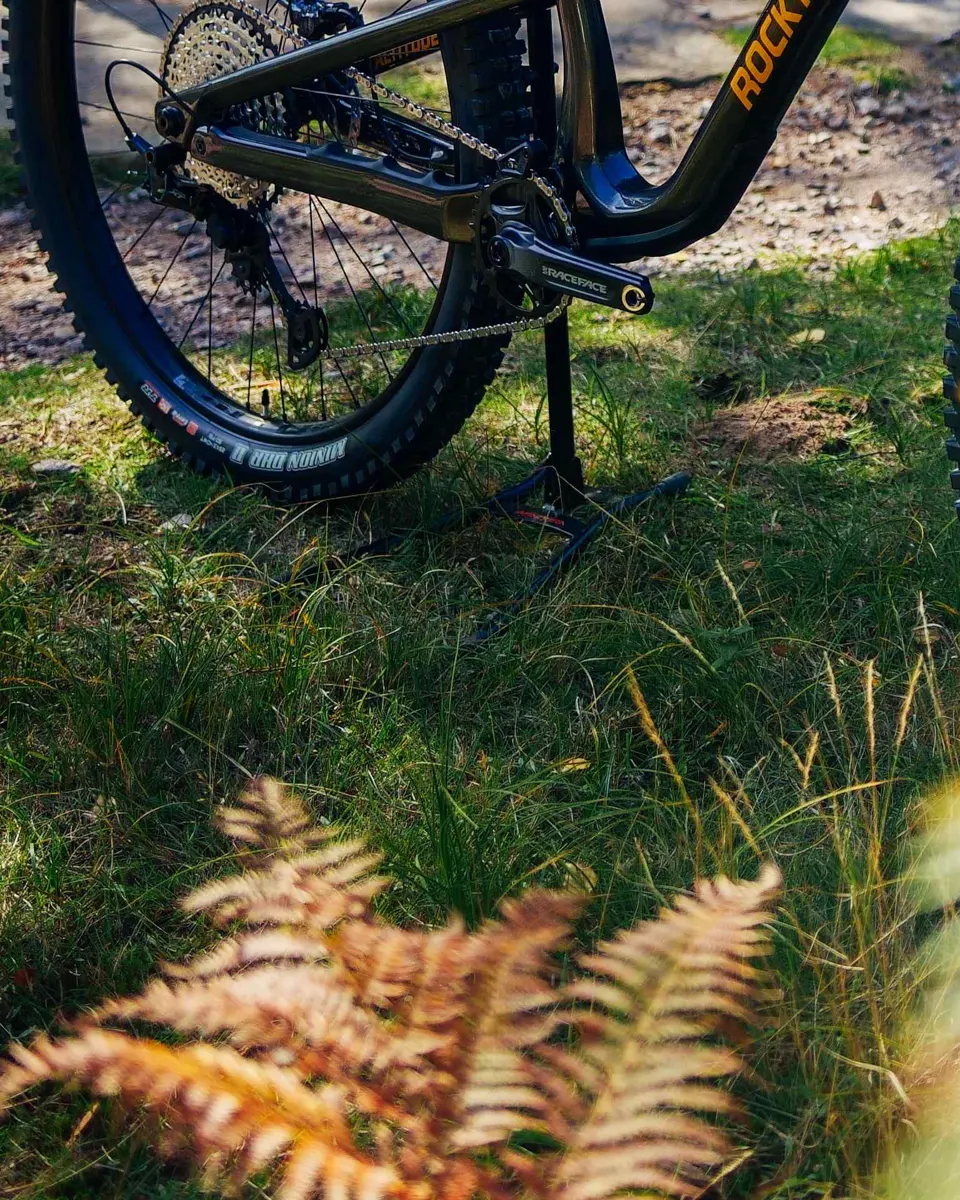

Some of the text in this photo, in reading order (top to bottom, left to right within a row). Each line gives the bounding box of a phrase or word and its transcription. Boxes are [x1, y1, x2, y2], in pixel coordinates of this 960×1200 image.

[547, 267, 608, 294] RACEFACE
[249, 450, 288, 471] DHR
[286, 437, 348, 472] MINION
